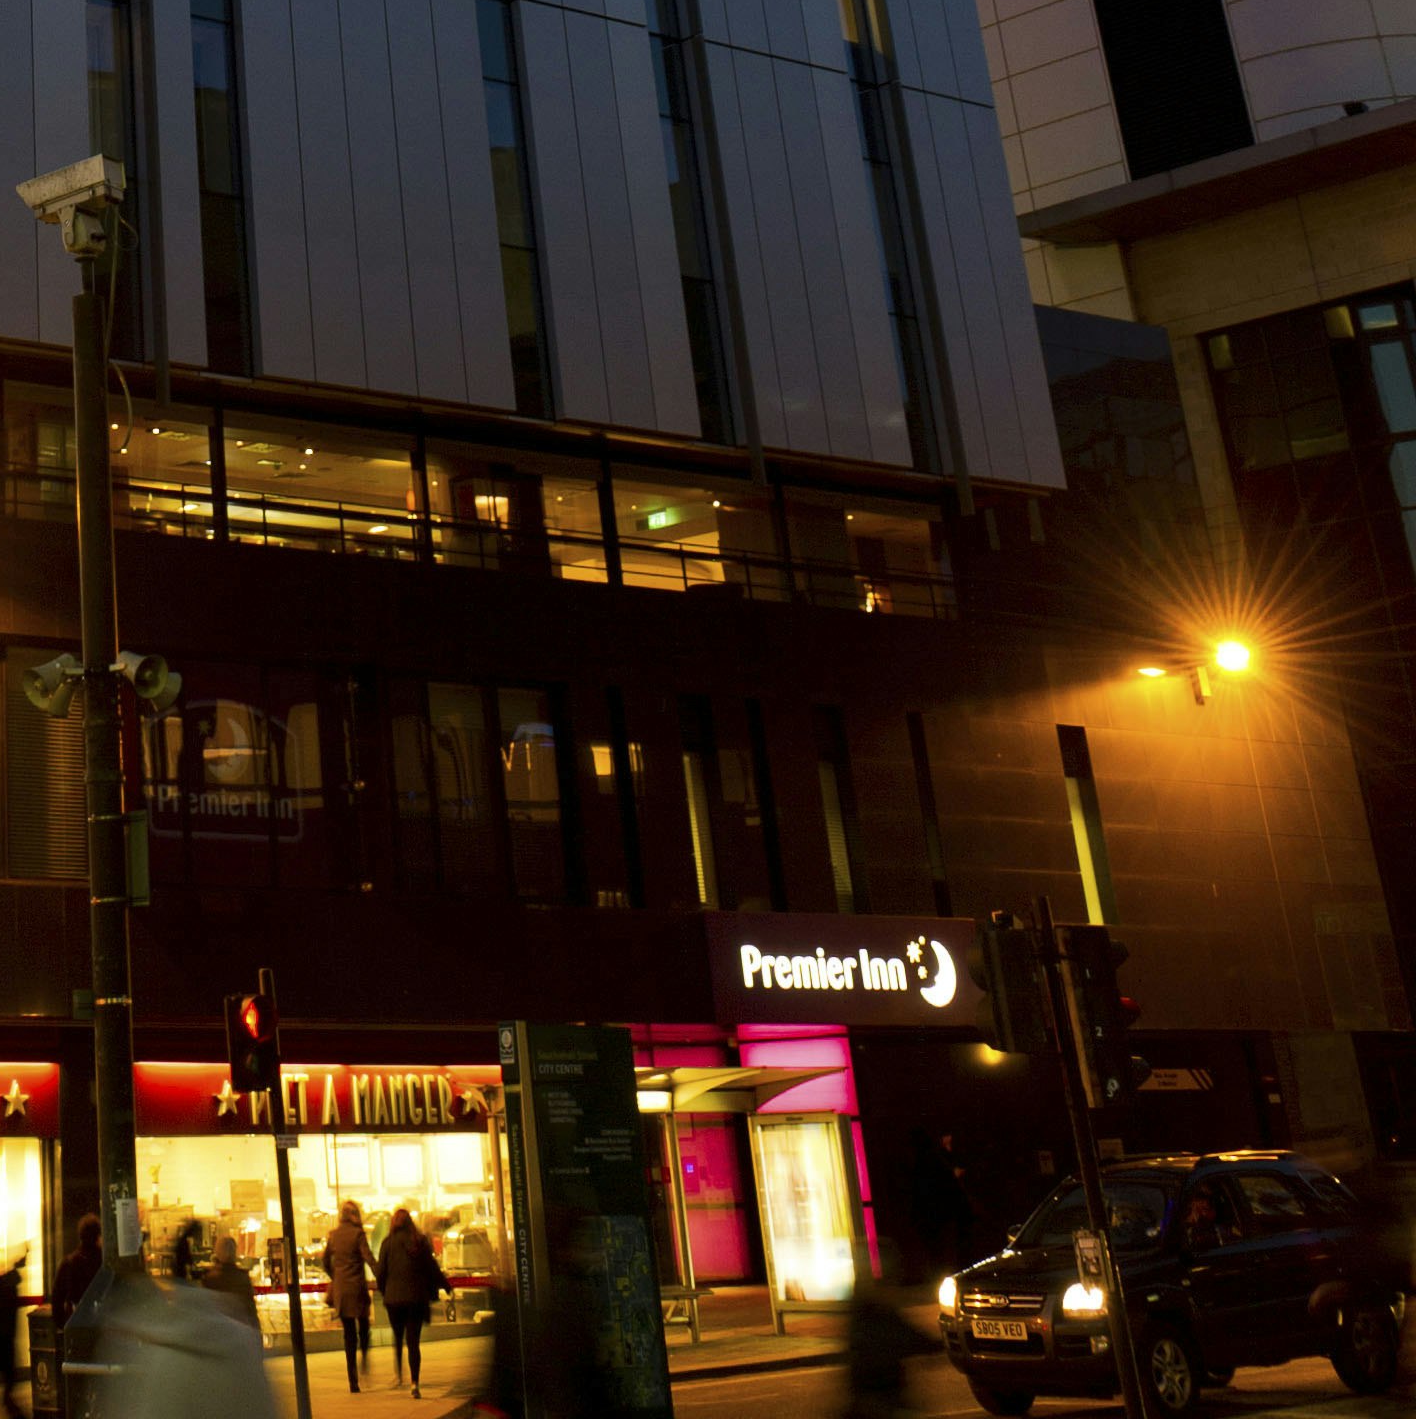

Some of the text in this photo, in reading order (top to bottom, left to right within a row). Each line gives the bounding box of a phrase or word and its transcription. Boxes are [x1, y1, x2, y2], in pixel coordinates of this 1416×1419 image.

[740, 944, 908, 991] Premier Inn
[322, 1074, 341, 1126] A
[352, 1074, 455, 1126] MANGER
[518, 1228, 527, 1254] CITY
